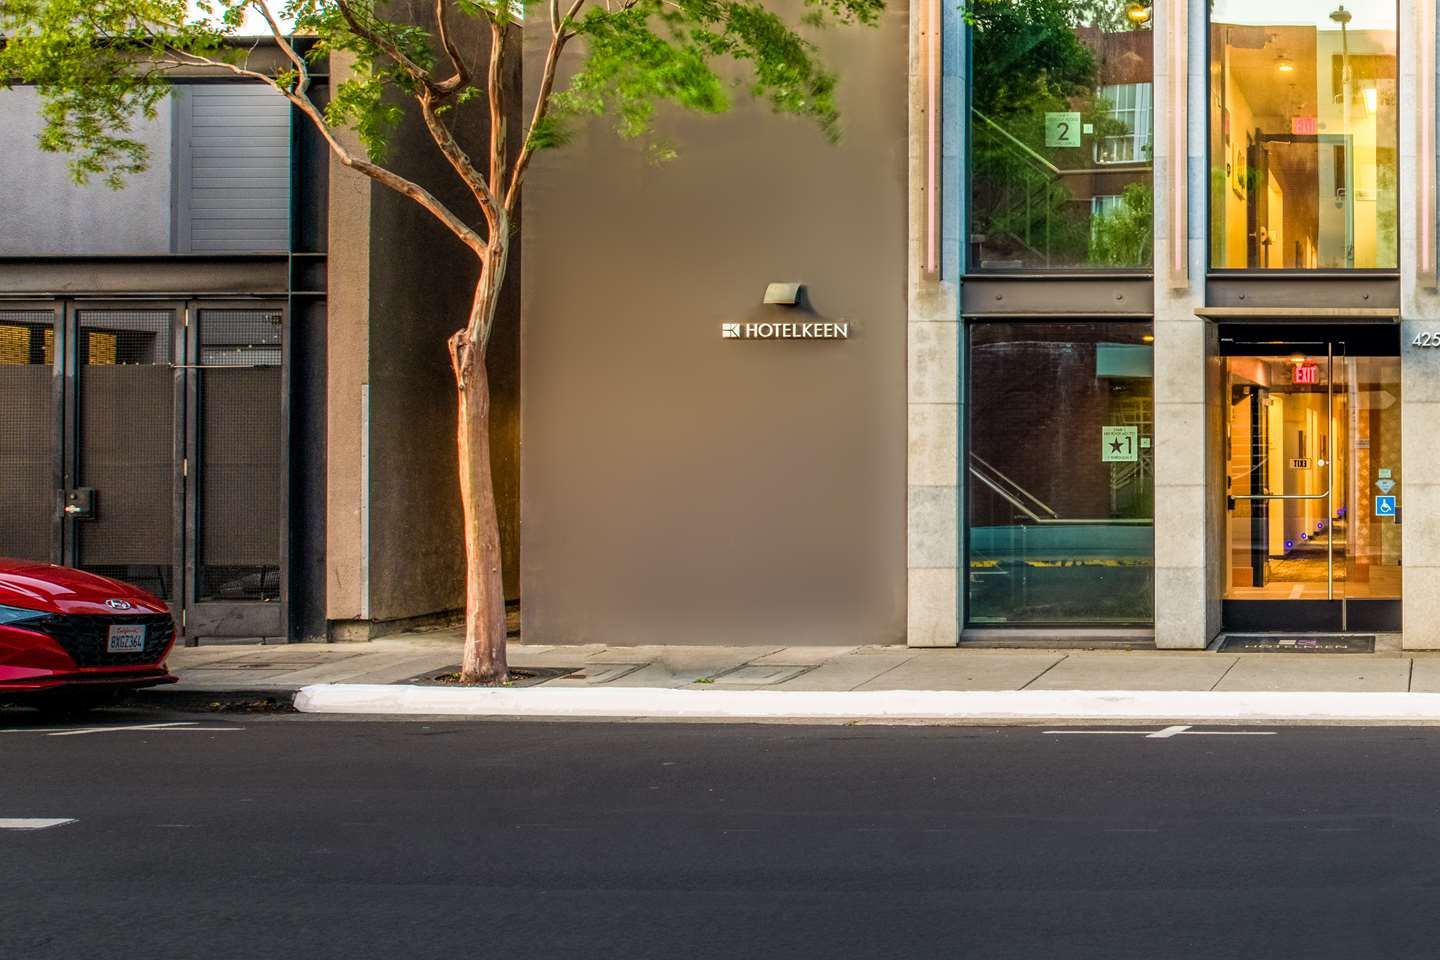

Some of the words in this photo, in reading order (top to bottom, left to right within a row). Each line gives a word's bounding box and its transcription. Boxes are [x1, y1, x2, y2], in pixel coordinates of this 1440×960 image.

[1057, 122, 1069, 140] 2
[746, 323, 848, 338] HOTELKEEN
[1412, 331, 1440, 347] 425
[1296, 366, 1316, 384] EXIT
[1125, 436, 1131, 454] 1
